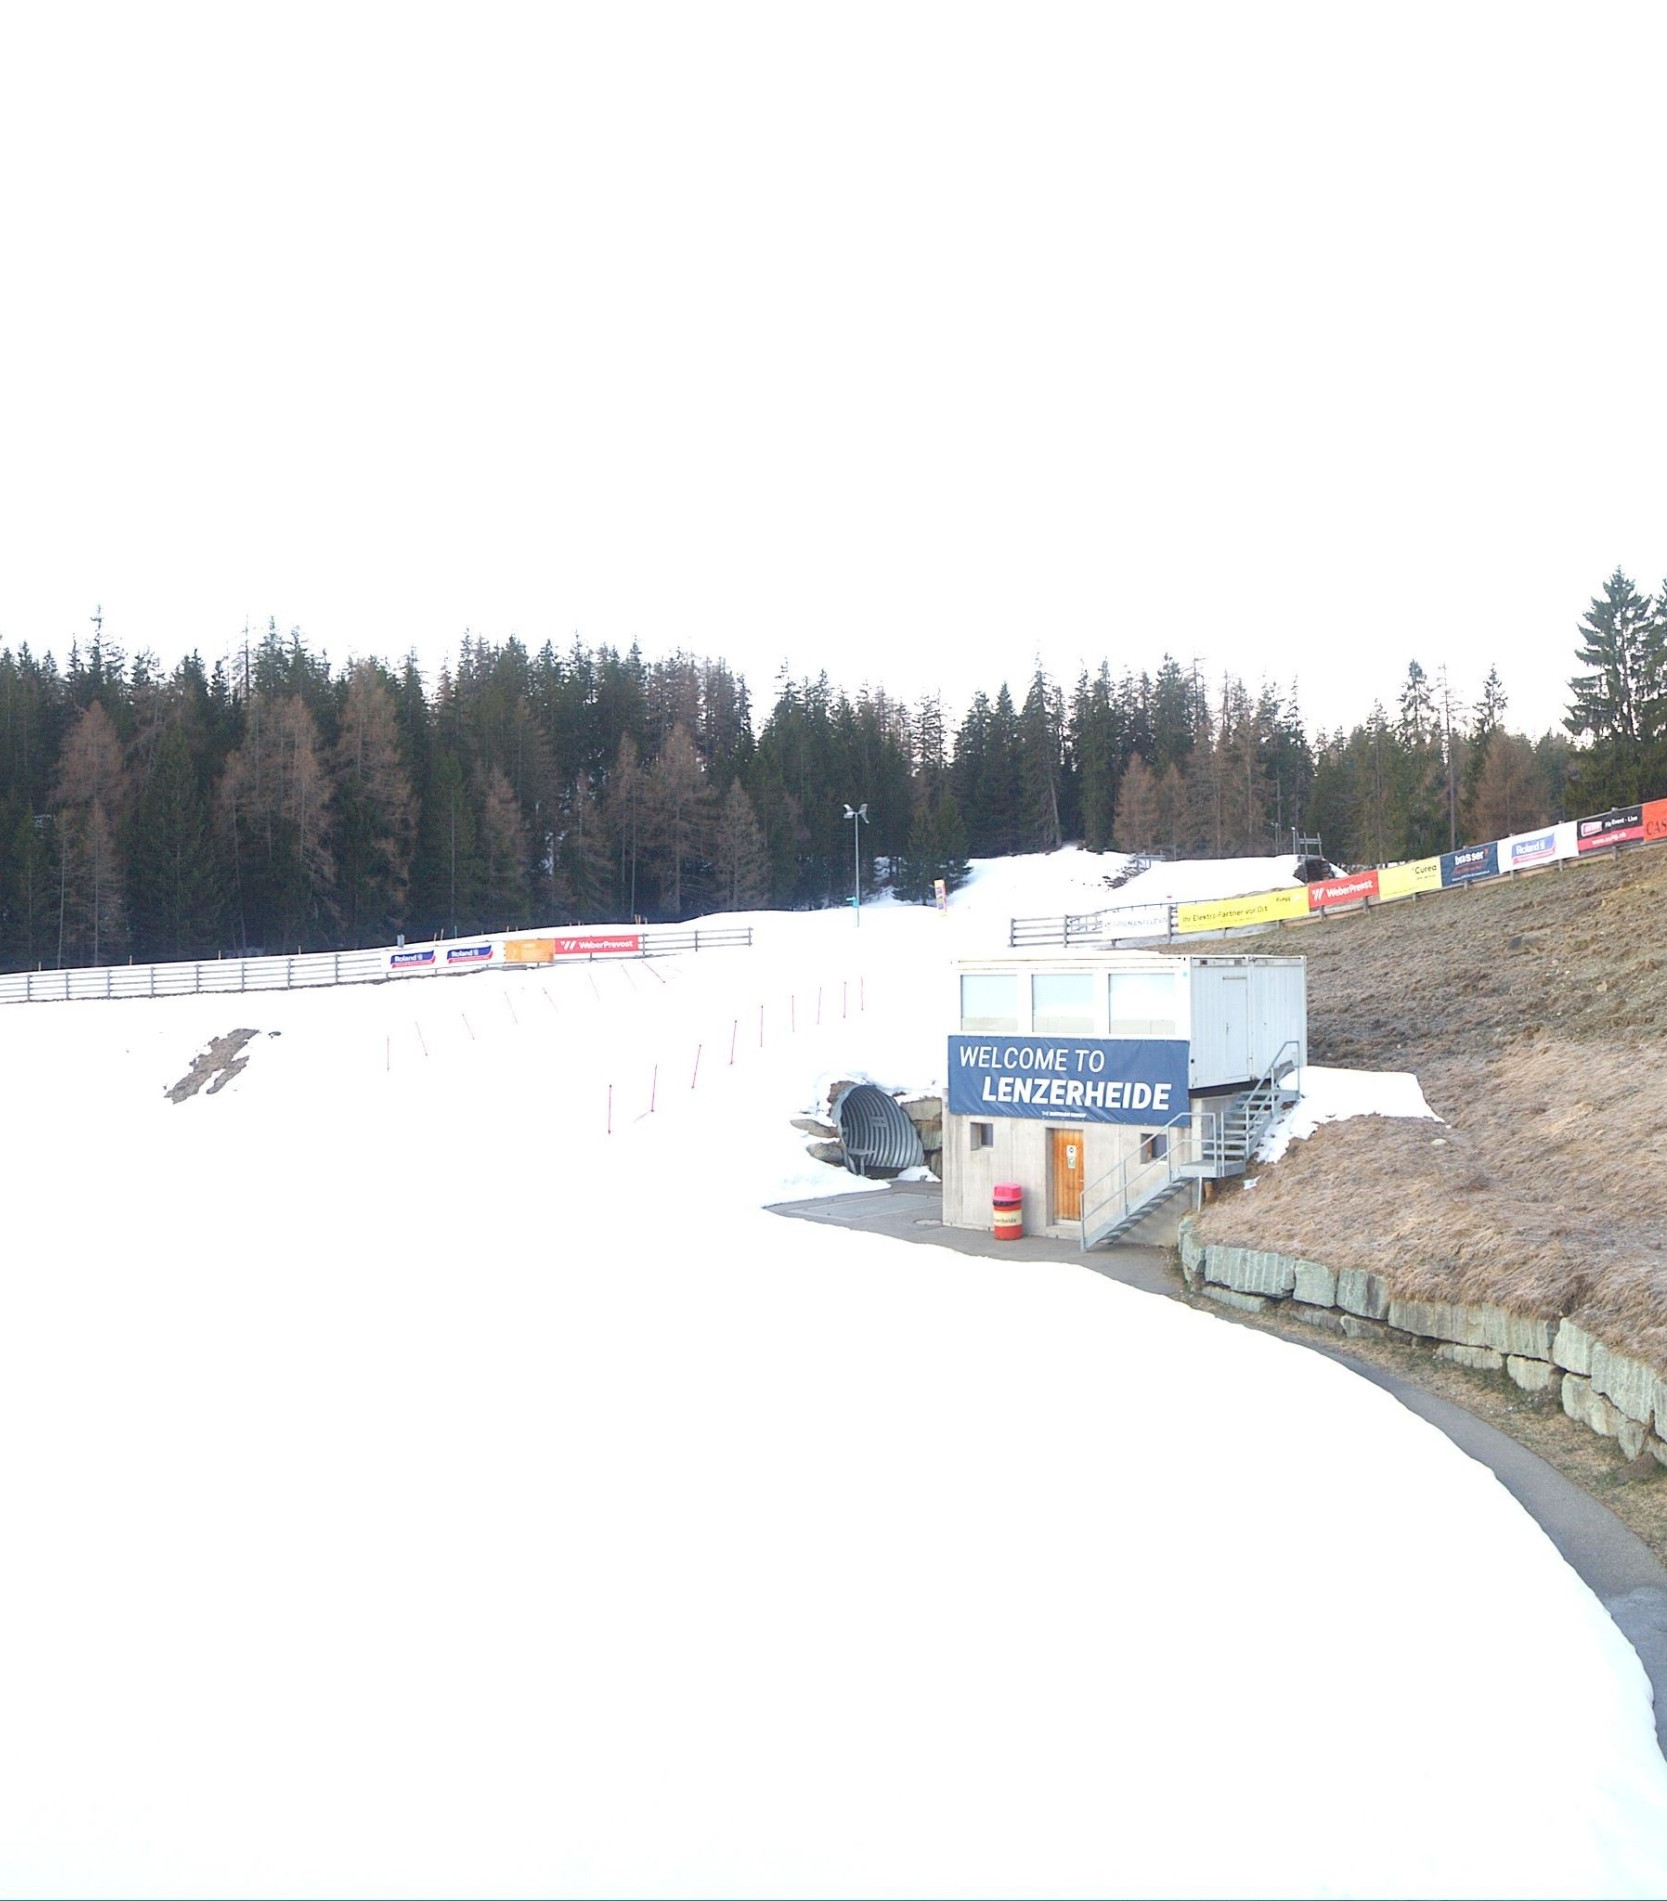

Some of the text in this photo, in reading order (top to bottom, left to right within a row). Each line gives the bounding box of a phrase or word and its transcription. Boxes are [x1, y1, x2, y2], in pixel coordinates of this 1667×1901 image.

[578, 940, 633, 949] WeberPrevost
[451, 949, 473, 957] Roland
[394, 954, 417, 962] Roland
[959, 1046, 1105, 1073] WELCOME TO
[982, 1076, 1173, 1111] LENZERHEIDE
